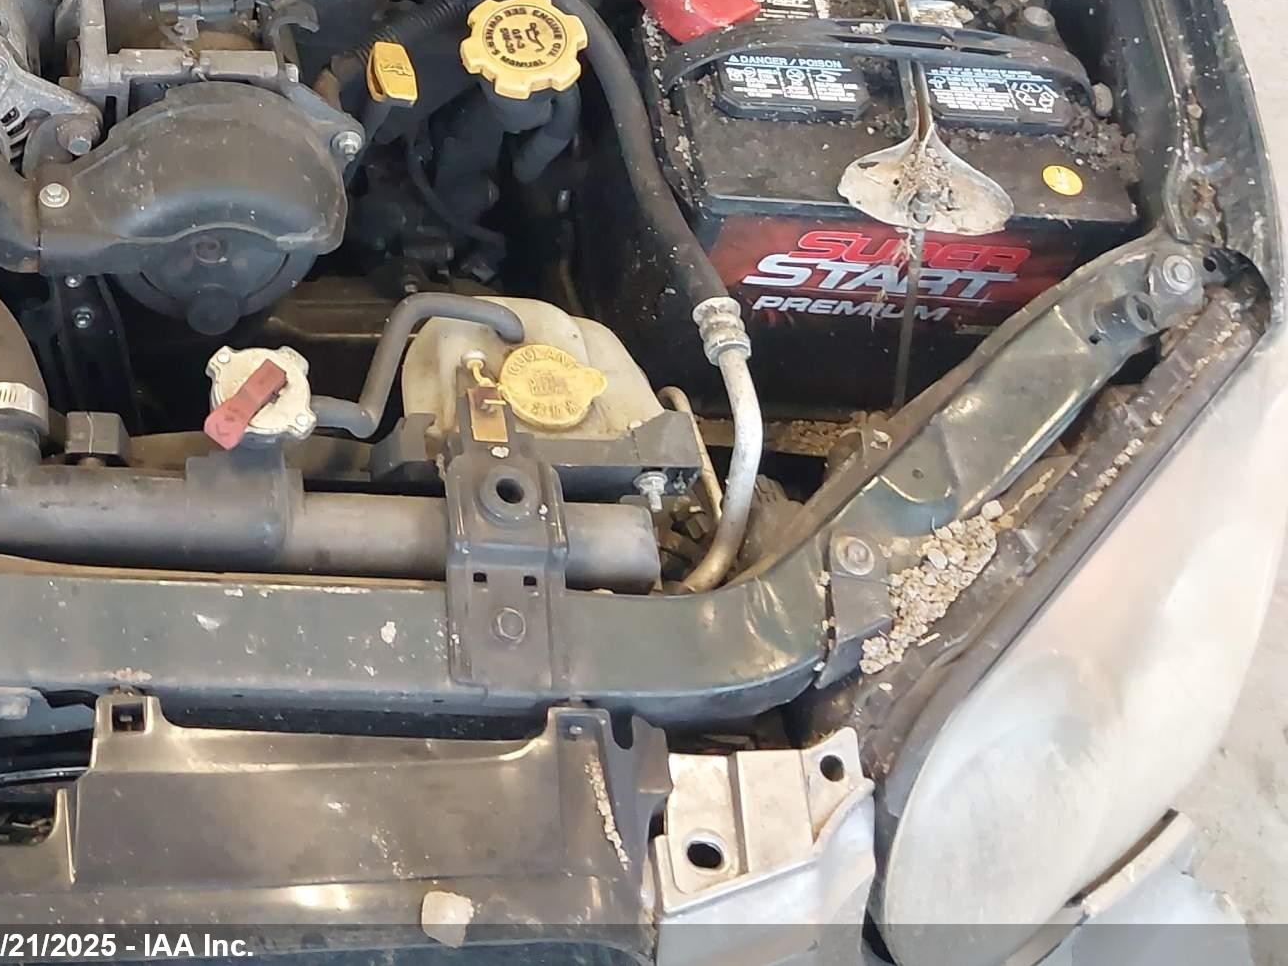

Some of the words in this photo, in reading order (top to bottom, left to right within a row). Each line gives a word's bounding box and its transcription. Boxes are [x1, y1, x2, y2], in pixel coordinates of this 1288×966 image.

[503, 7, 528, 17] SEE
[532, 9, 563, 40] ENGINE
[546, 42, 562, 58] OIL
[500, 55, 546, 68] MANUAL
[738, 55, 788, 66] DANGER
[798, 59, 843, 69] POISON
[787, 230, 1031, 272] SUPER
[742, 253, 1018, 299] START
[752, 295, 951, 322] PREMIUM
